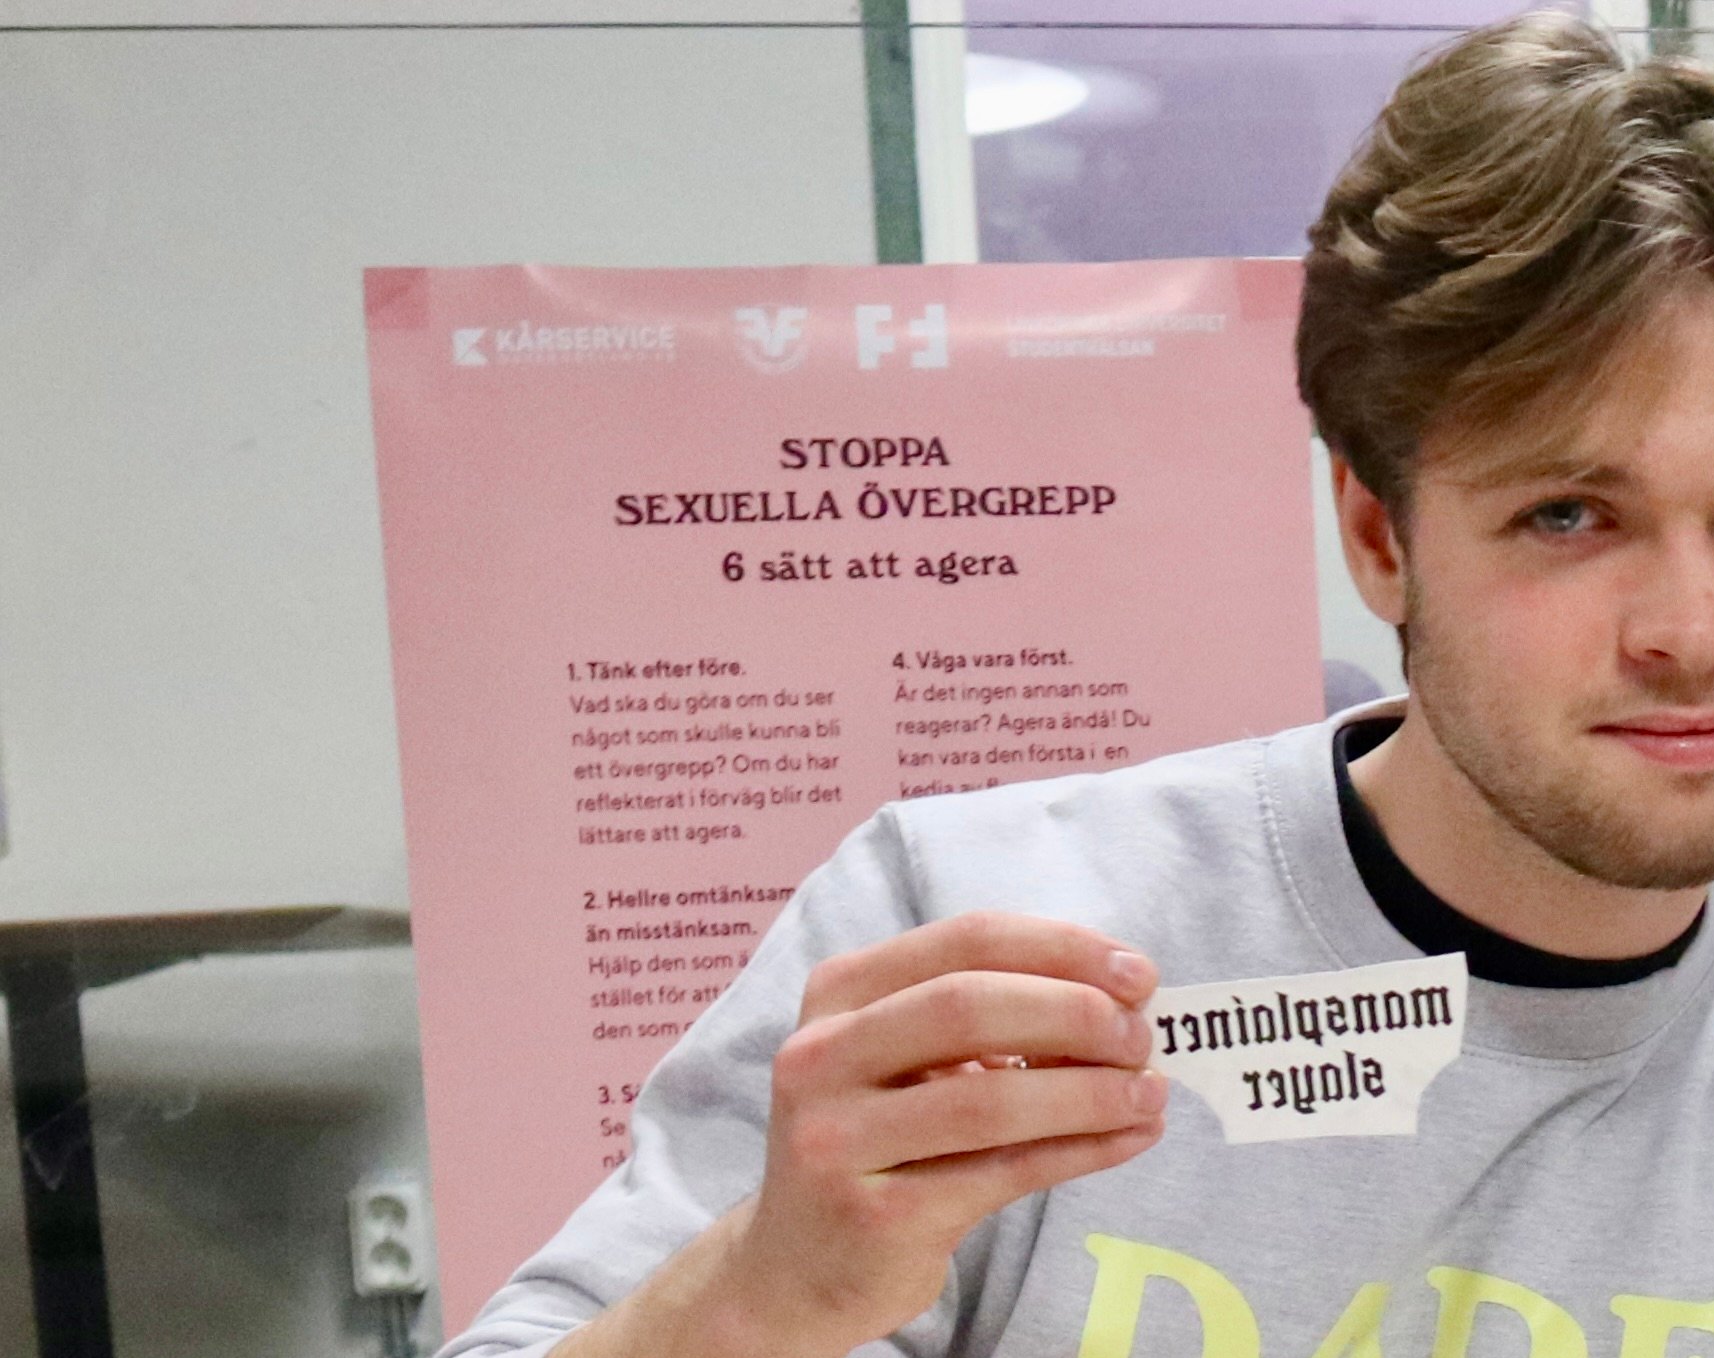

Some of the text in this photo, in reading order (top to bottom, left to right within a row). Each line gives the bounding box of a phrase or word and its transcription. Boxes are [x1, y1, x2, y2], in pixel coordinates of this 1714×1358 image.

[780, 437, 949, 470] STOPPA
[614, 482, 1117, 526] SEXUELLA ÖVERGREPP
[722, 551, 1019, 585] 6 sätt att agera
[567, 656, 747, 681] 1. Tänk efter före.
[891, 648, 1074, 673] 4. Våga vara först.
[568, 688, 835, 715] Vad ska du göra om du ser
[895, 679, 1128, 704] Är det ingen annan som
[571, 719, 841, 751] något som skulle kunna bli
[895, 709, 1151, 738] reagerar? Agera ändå! Du
[573, 752, 840, 781] ett övergrepp? Om du har
[897, 748, 934, 767] kan
[940, 750, 981, 765] vara
[985, 747, 1023, 764] den
[1027, 744, 1086, 763] första
[1103, 745, 1129, 760] en
[576, 792, 684, 814] reflekterat
[699, 787, 765, 810] förväg
[770, 785, 803, 805] blir
[807, 785, 842, 804] det
[578, 825, 646, 845] lättare
[651, 824, 680, 843] att
[583, 885, 795, 910] 2. Hellre omtänksam
[586, 920, 757, 942] än misstänksam.
[588, 957, 642, 978] Hjälp
[647, 955, 686, 973] den
[690, 955, 733, 971] som
[590, 987, 653, 1008] stället
[658, 986, 686, 1004] för
[692, 985, 720, 1002] att
[592, 1022, 632, 1040] den
[638, 1021, 679, 1038] som
[598, 1085, 615, 1104] 3.
